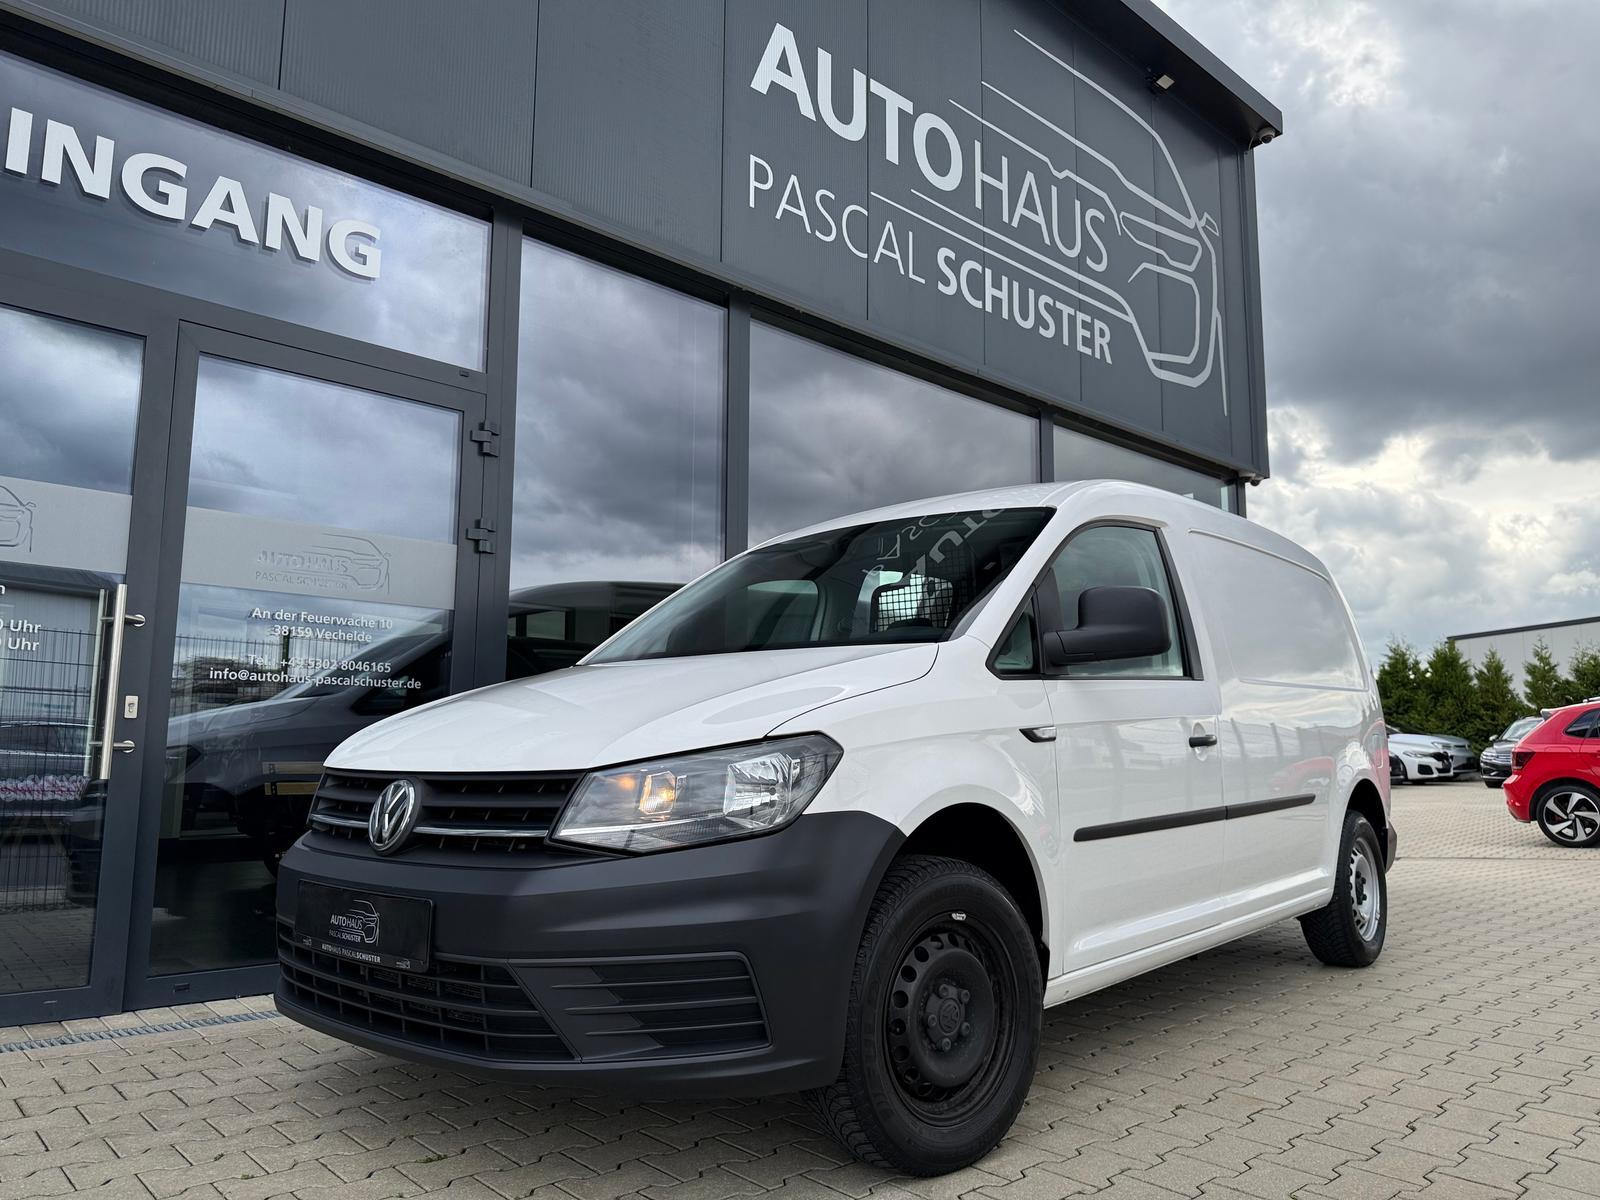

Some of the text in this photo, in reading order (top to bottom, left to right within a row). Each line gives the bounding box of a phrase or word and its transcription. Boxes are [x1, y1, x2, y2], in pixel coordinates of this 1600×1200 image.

[750, 23, 1109, 273] AUTOHAUS
[748, 153, 1113, 365] PASCAL SCHUSTER
[9, 619, 42, 633] Uhr
[251, 607, 393, 630] An der Feuerwache 10
[273, 624, 372, 643] 38159 Vechelde
[7, 637, 40, 651] Uhr
[307, 657, 337, 671] 5302
[341, 659, 392, 673] 8046165
[209, 667, 422, 690] info@autohaus-pascalschuster.de
[330, 913, 363, 930] AUTOHAUS
